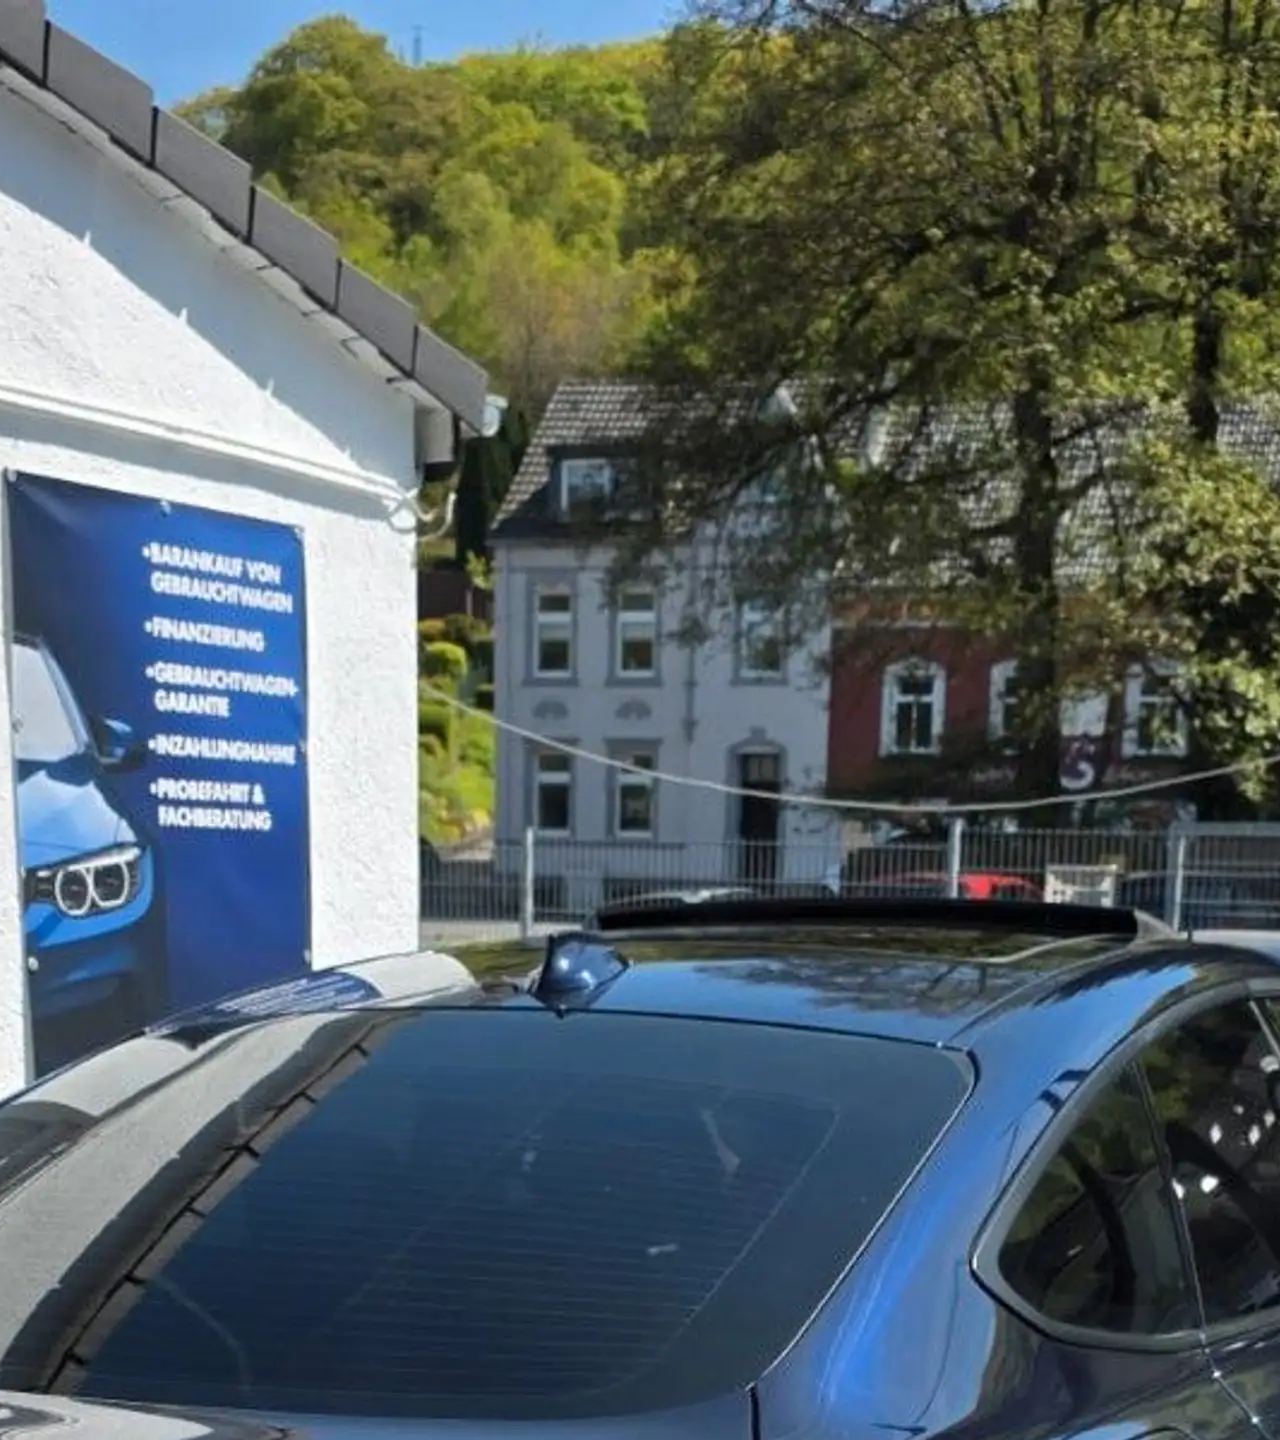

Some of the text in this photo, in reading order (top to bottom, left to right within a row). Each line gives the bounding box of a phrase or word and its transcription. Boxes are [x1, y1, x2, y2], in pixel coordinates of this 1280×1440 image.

[150, 542, 282, 585] BARANKAUF VON
[150, 572, 293, 613] GEBRAUCHTWAGEN
[152, 616, 265, 652] FINANZIERUNG
[154, 690, 230, 718] GARANTIE
[154, 733, 297, 767] INZAHLUNGNAHME
[156, 776, 266, 806] PROBEFAHRT &
[157, 805, 273, 832] FACHBERATUNG
